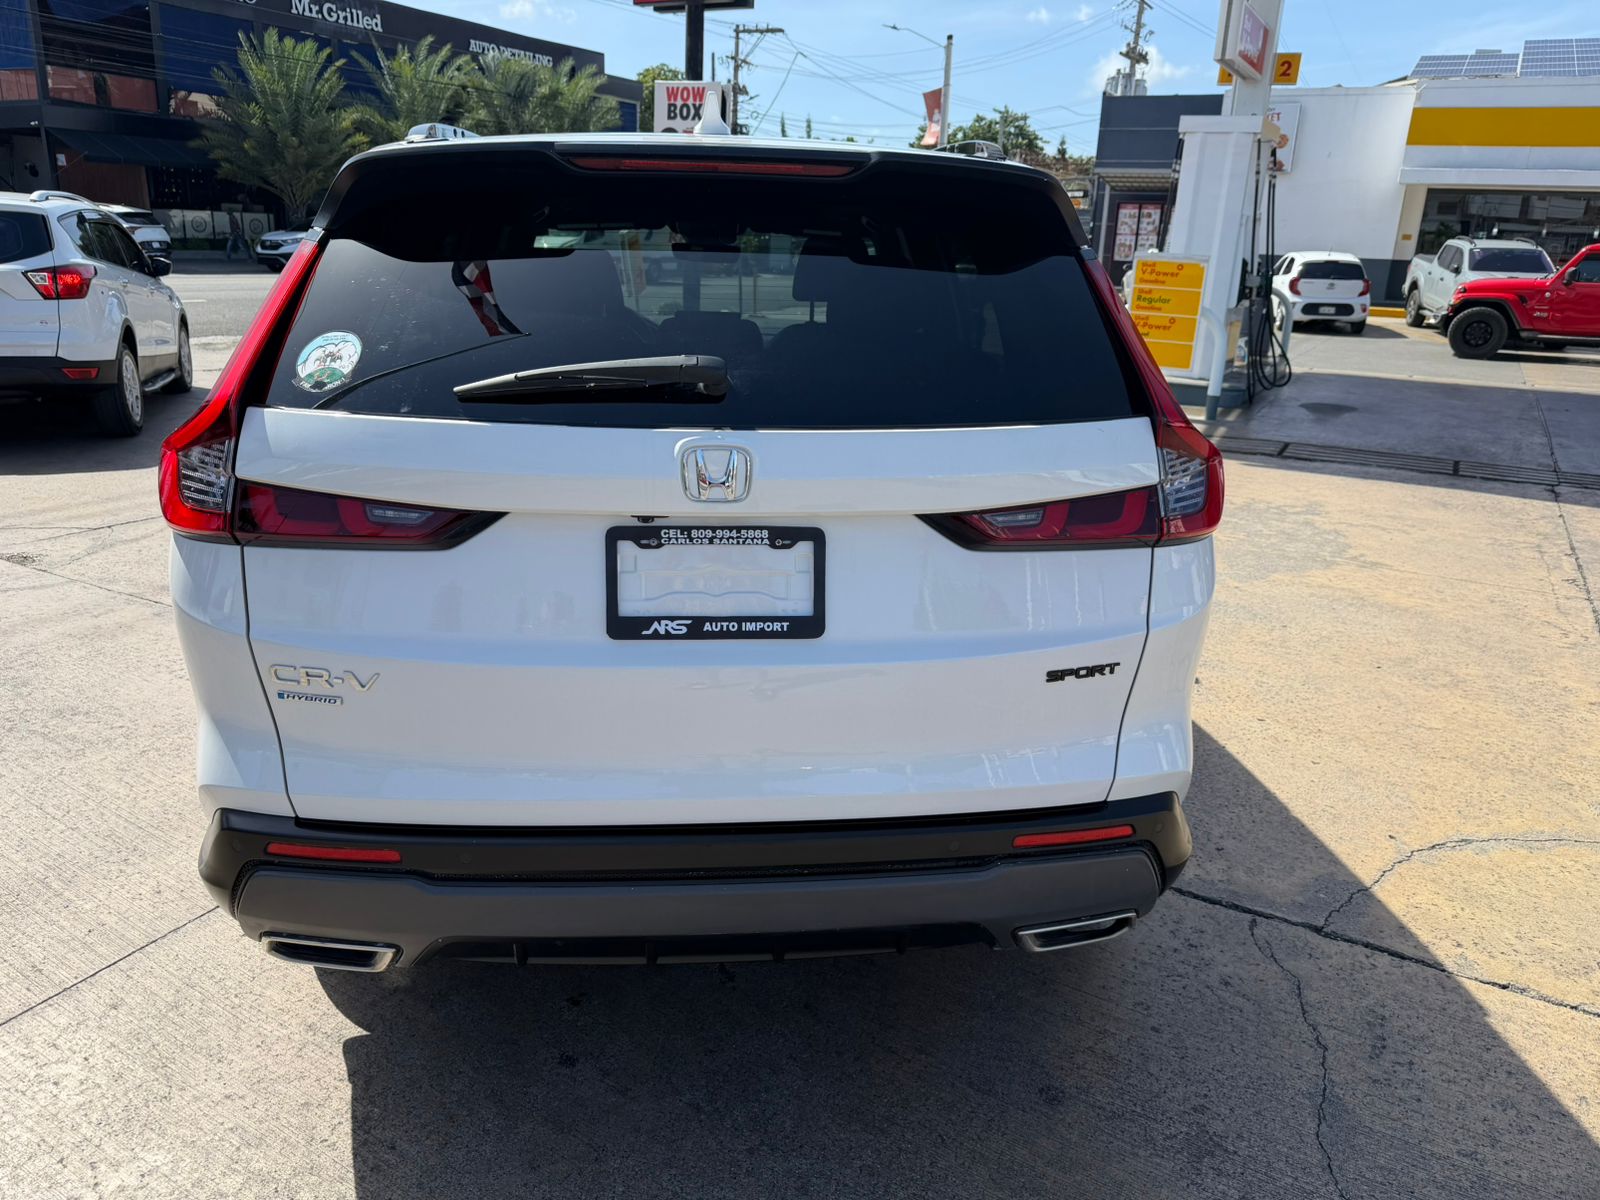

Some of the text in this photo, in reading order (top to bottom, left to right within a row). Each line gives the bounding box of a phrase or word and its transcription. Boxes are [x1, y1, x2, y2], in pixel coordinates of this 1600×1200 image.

[469, 39, 553, 67] AUTO DETAILING
[1279, 60, 1292, 77] 2
[666, 86, 706, 103] WOW
[667, 103, 703, 121] BOX
[1141, 268, 1180, 278] V-Power
[1136, 295, 1171, 304] Regular
[661, 529, 769, 538] CEL: 809-994-5868
[703, 621, 738, 631] AUTO
[742, 621, 790, 632] IMPORT
[270, 664, 380, 692] CR-V
[1046, 662, 1120, 683] SPORT
